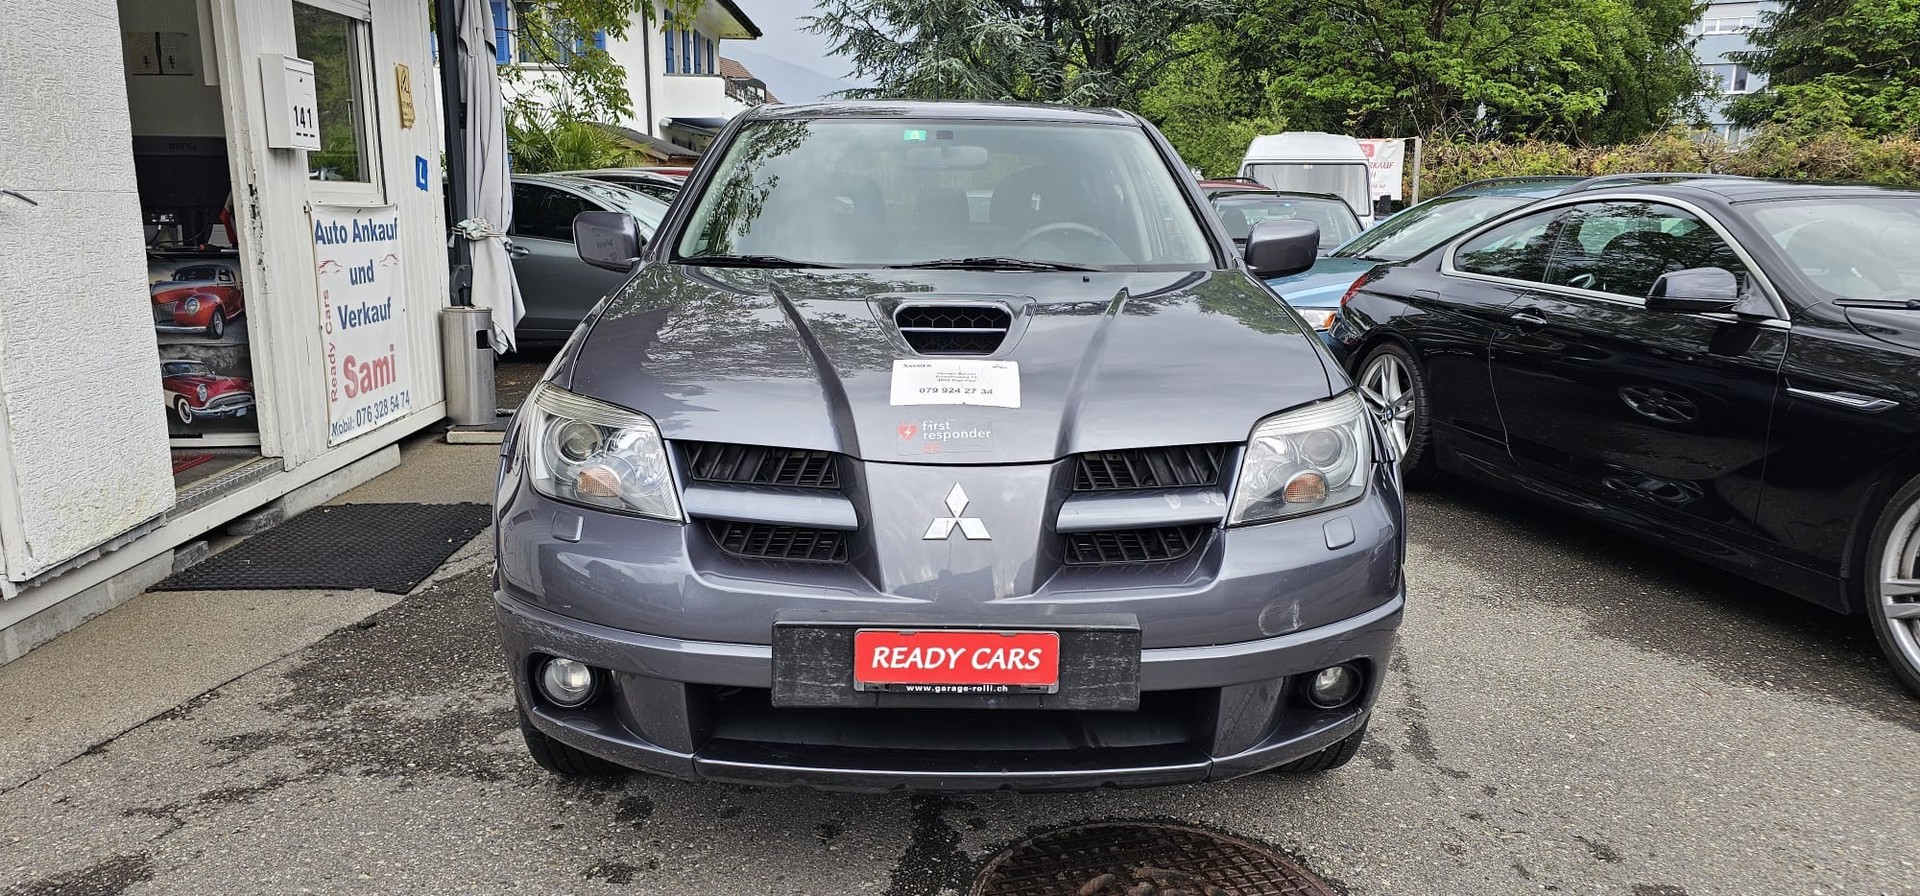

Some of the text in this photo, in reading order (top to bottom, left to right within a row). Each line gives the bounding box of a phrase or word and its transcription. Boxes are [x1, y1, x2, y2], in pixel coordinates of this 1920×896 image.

[293, 105, 313, 129] 141
[419, 162, 425, 184] L
[1369, 161, 1395, 170] RKAUF
[315, 217, 398, 245] Auto Ankauf
[349, 259, 375, 286] und
[337, 296, 392, 330] Verkauf
[327, 342, 338, 402] Ready
[343, 343, 397, 399] Sami
[964, 387, 977, 395] 27
[331, 390, 410, 437] Mobil: 076 328 54 74
[922, 420, 951, 431] first
[923, 428, 992, 441] responder
[871, 646, 1043, 670] READY CARS
[906, 684, 1008, 694] www.garage-rolli.ch
